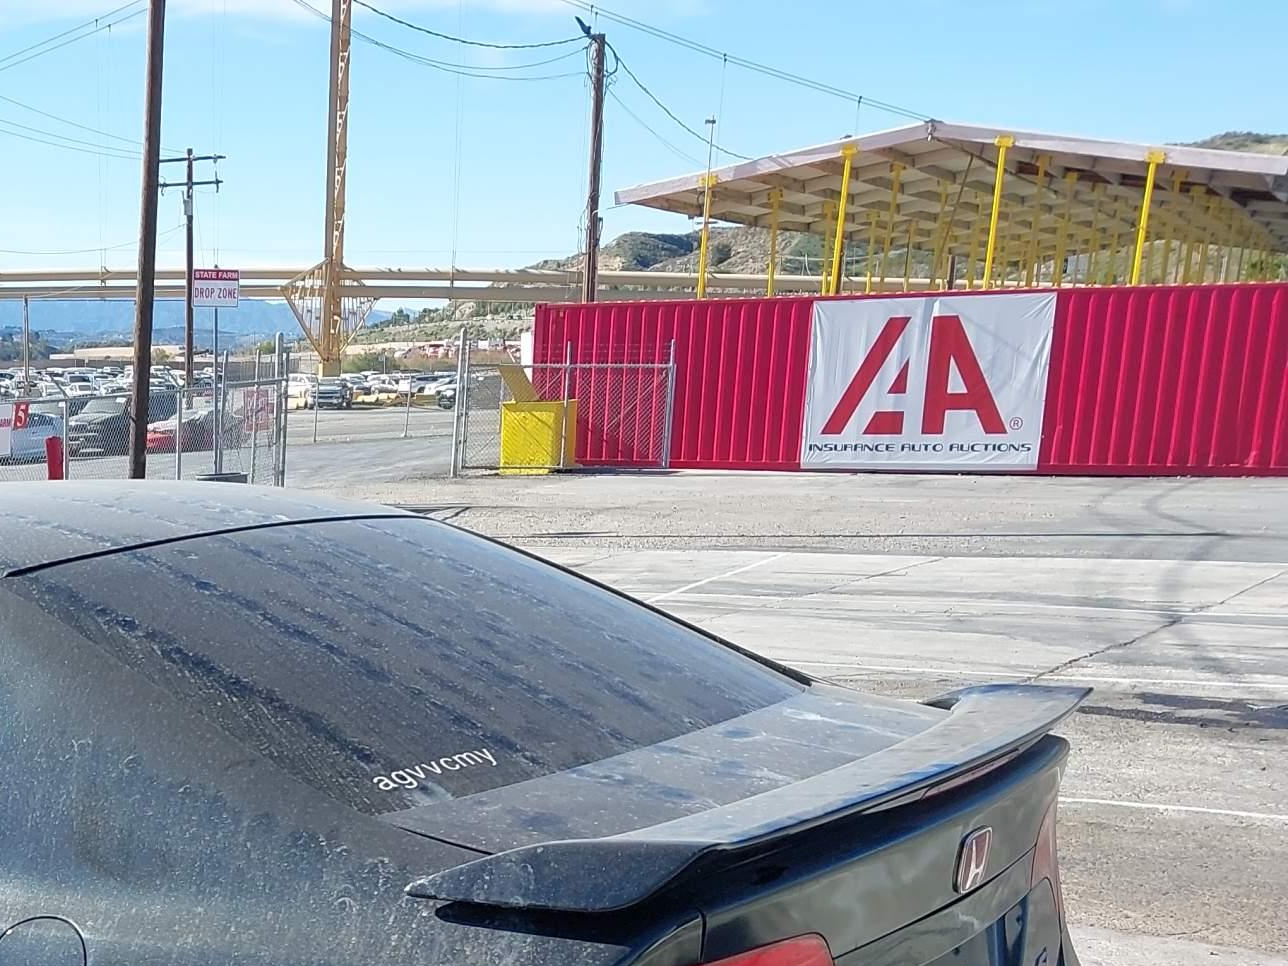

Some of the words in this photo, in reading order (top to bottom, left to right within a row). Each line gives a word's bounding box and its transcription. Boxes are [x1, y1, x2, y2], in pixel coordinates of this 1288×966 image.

[194, 271, 217, 279] STATE
[218, 271, 238, 279] FARM
[194, 287, 216, 299] DROP
[217, 287, 237, 299] ZONE
[16, 404, 27, 427] 5
[809, 442, 896, 453] INSURANCE
[901, 442, 944, 453] AUTO
[948, 442, 1032, 453] AUCTIONS
